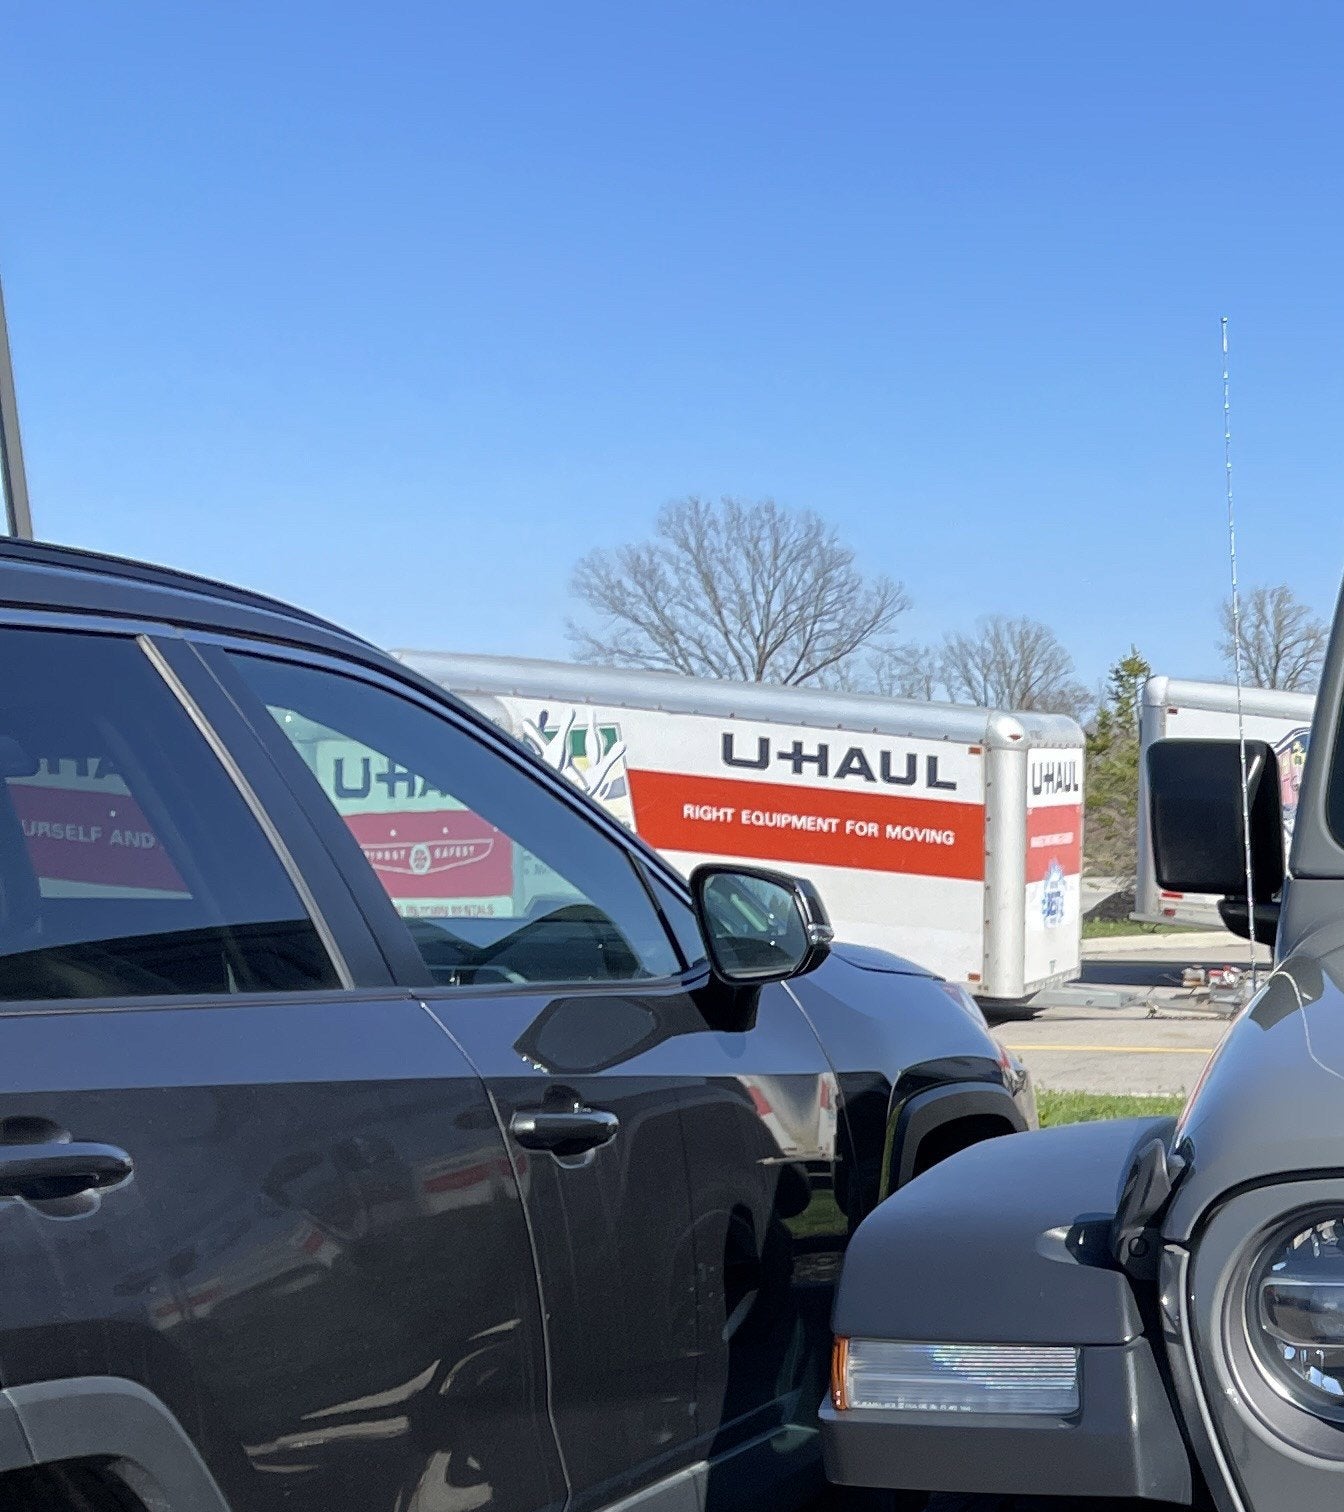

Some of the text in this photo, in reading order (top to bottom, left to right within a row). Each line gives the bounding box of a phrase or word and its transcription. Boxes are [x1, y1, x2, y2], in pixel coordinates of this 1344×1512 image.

[721, 732, 957, 791] U-HAUL
[1031, 761, 1079, 795] U-HAUL
[22, 819, 156, 849] URSELF AND
[682, 803, 956, 846] RIGHT EQUIPMENT FOR MOVING
